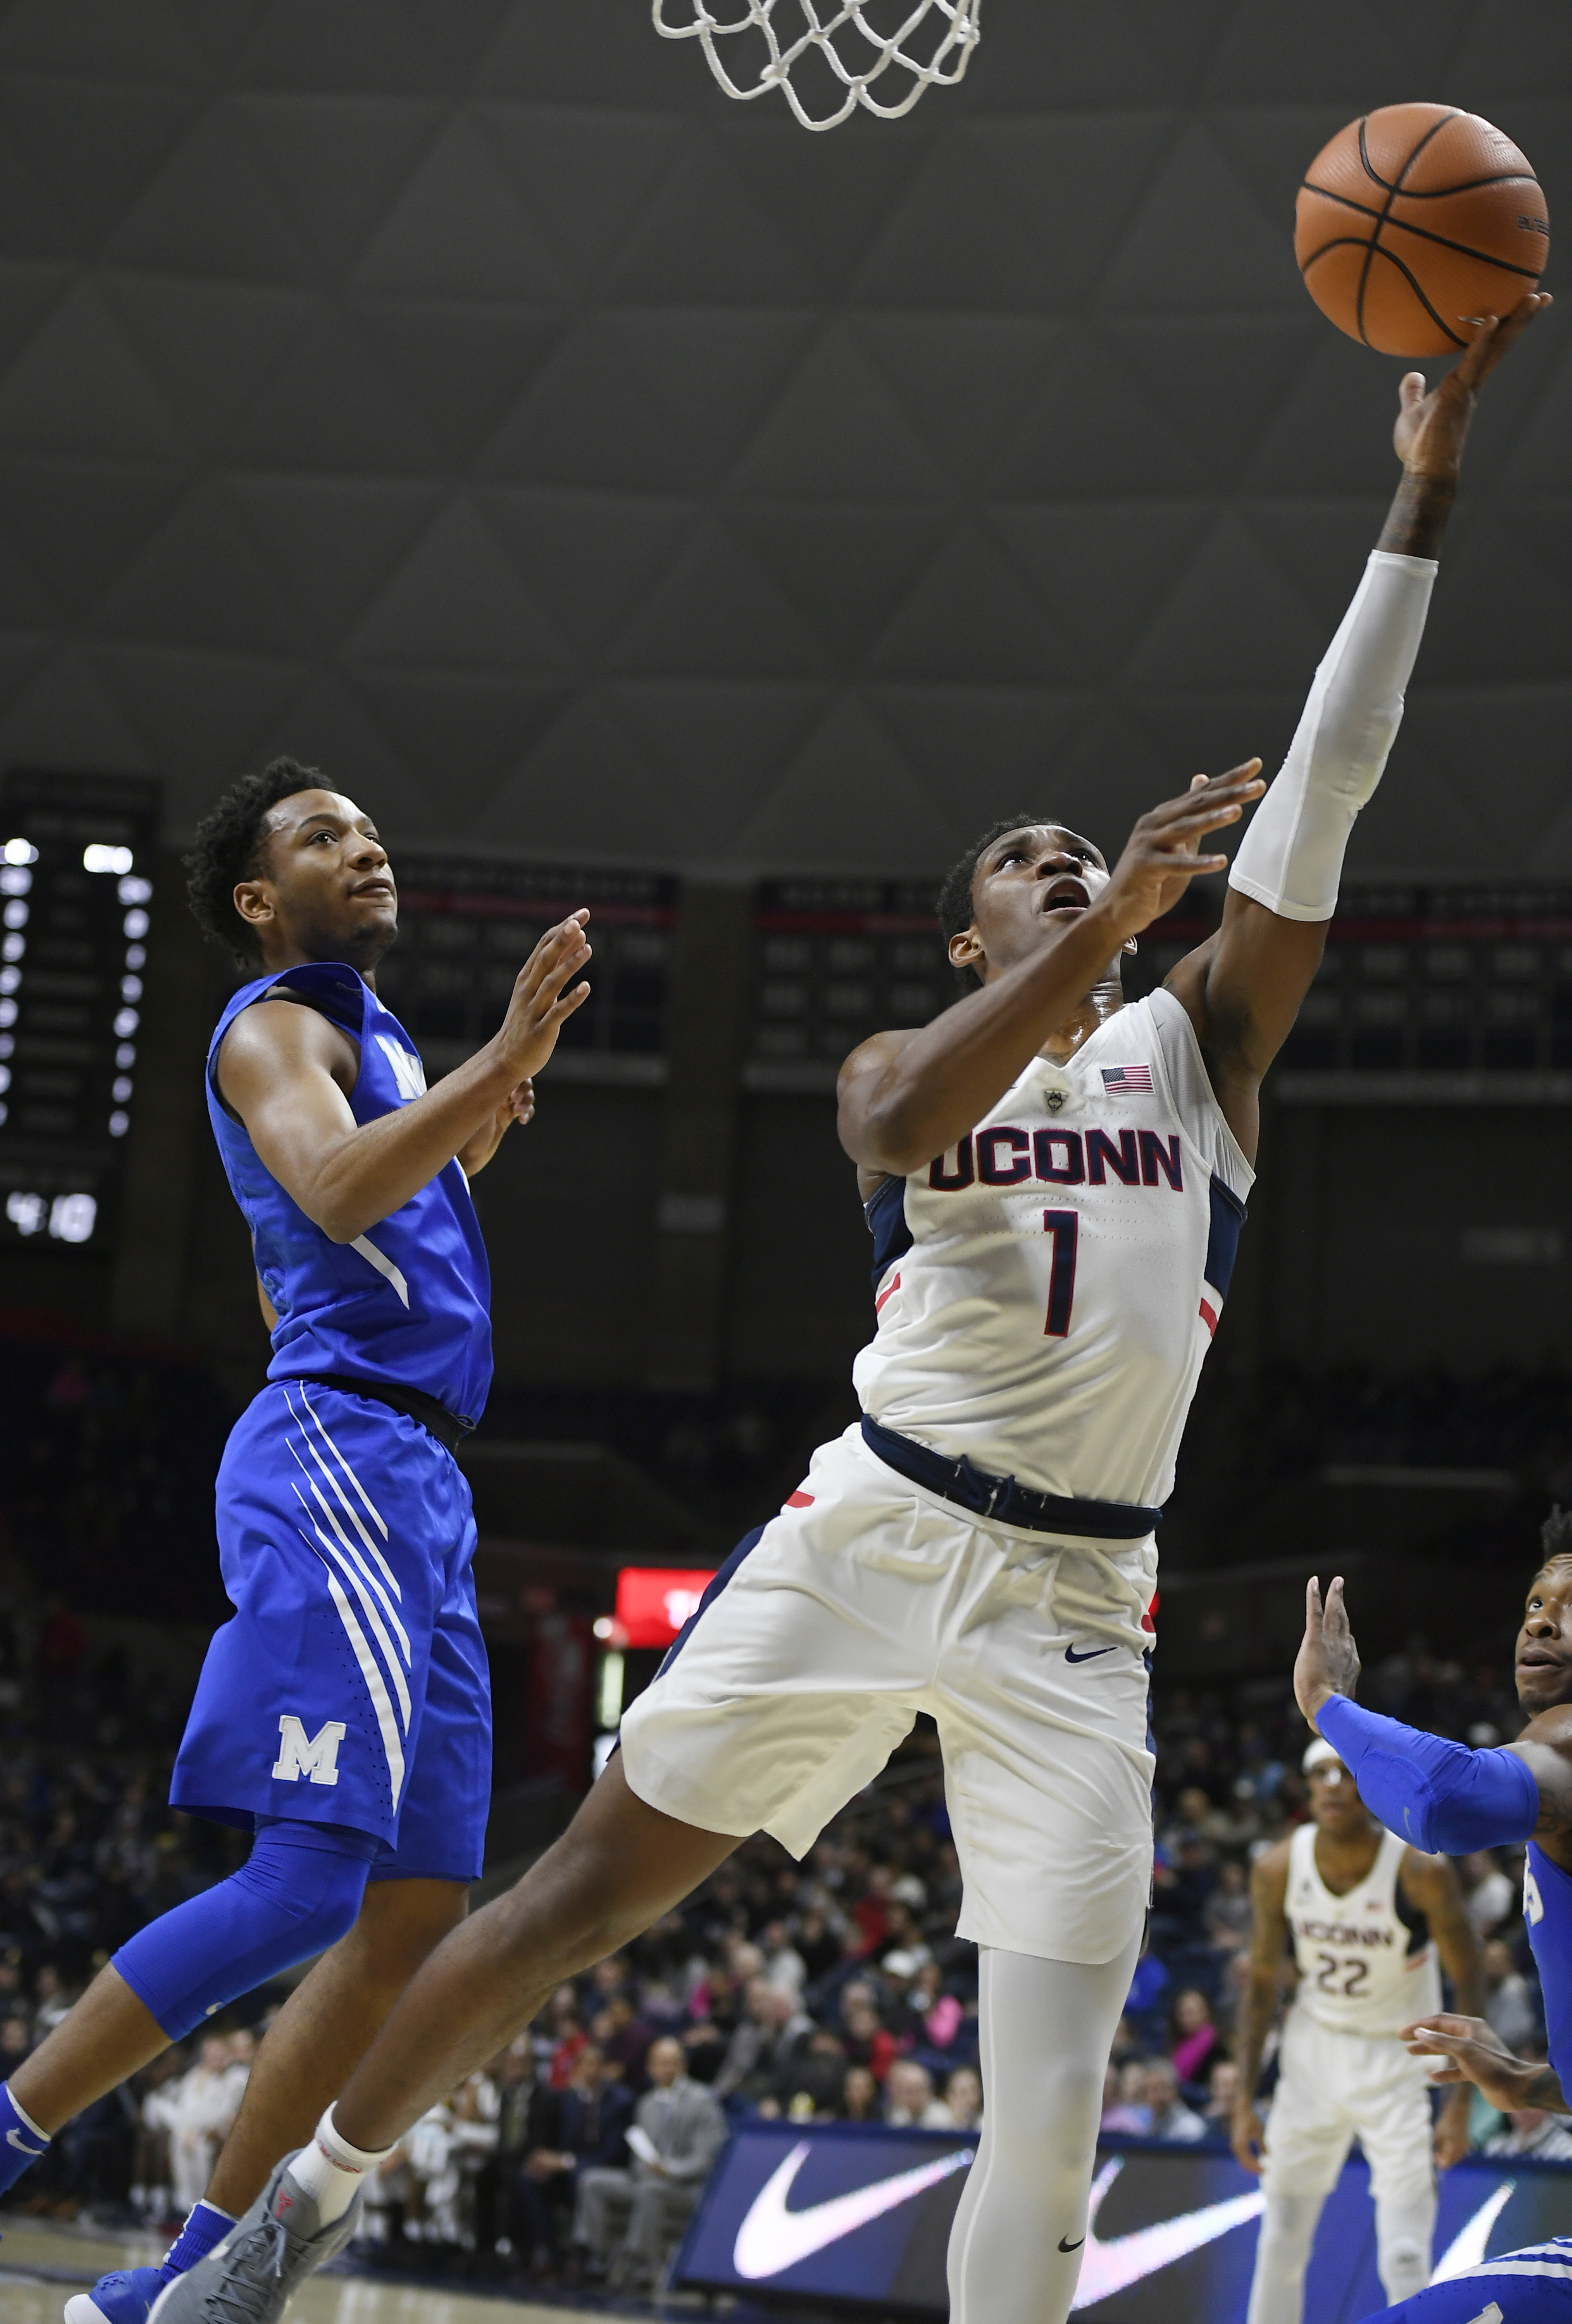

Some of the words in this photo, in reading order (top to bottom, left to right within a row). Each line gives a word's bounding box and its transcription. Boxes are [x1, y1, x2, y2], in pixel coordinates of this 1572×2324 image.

[929, 1126, 1184, 1192] UCONN
[1043, 1209, 1078, 1337] 1
[271, 1714, 347, 1786] M
[1316, 1952, 1371, 1997] 22
